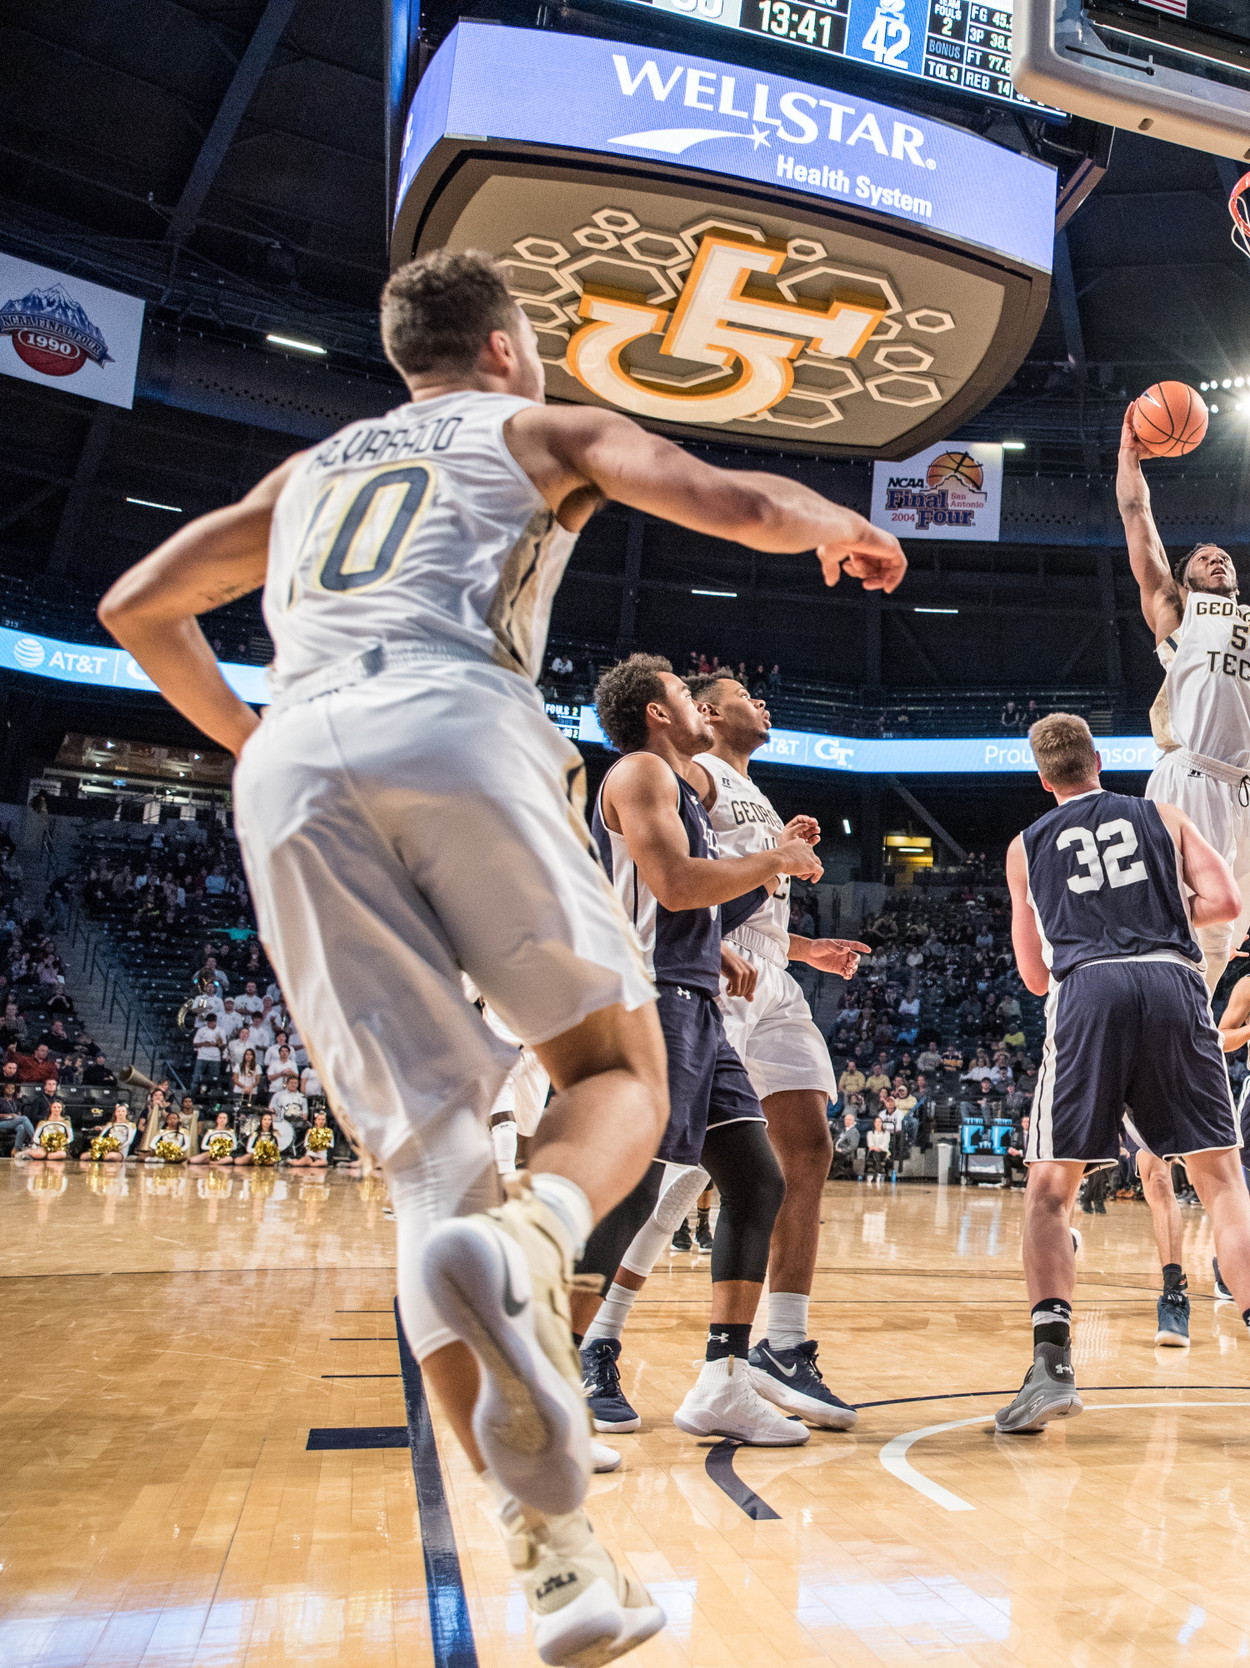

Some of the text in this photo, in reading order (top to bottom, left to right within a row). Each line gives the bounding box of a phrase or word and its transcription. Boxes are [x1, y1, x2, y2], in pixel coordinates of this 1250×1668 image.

[934, 4, 962, 21] FOULS
[971, 5, 988, 22] FG
[758, 0, 832, 47] 13:41
[941, 17, 953, 36] 2
[862, 16, 911, 70] 42
[969, 27, 984, 42] 3P
[929, 39, 960, 59] BONUS
[967, 49, 982, 66] FT
[928, 61, 949, 79] TOL
[966, 72, 990, 90] REB
[776, 154, 933, 218] Health System
[2, 314, 101, 353] NCAA FINAL FOUR
[27, 332, 72, 355] 1990
[888, 478, 924, 488] NCAA
[886, 489, 949, 510] Final
[891, 513, 916, 521] 2004
[916, 510, 974, 530] Four
[1231, 624, 1250, 651] 5
[48, 651, 107, 674] AT&T
[546, 704, 578, 717] FOULS 2
[814, 738, 854, 766] GT
[985, 745, 1035, 764] Prou
[1056, 818, 1149, 894] 32
